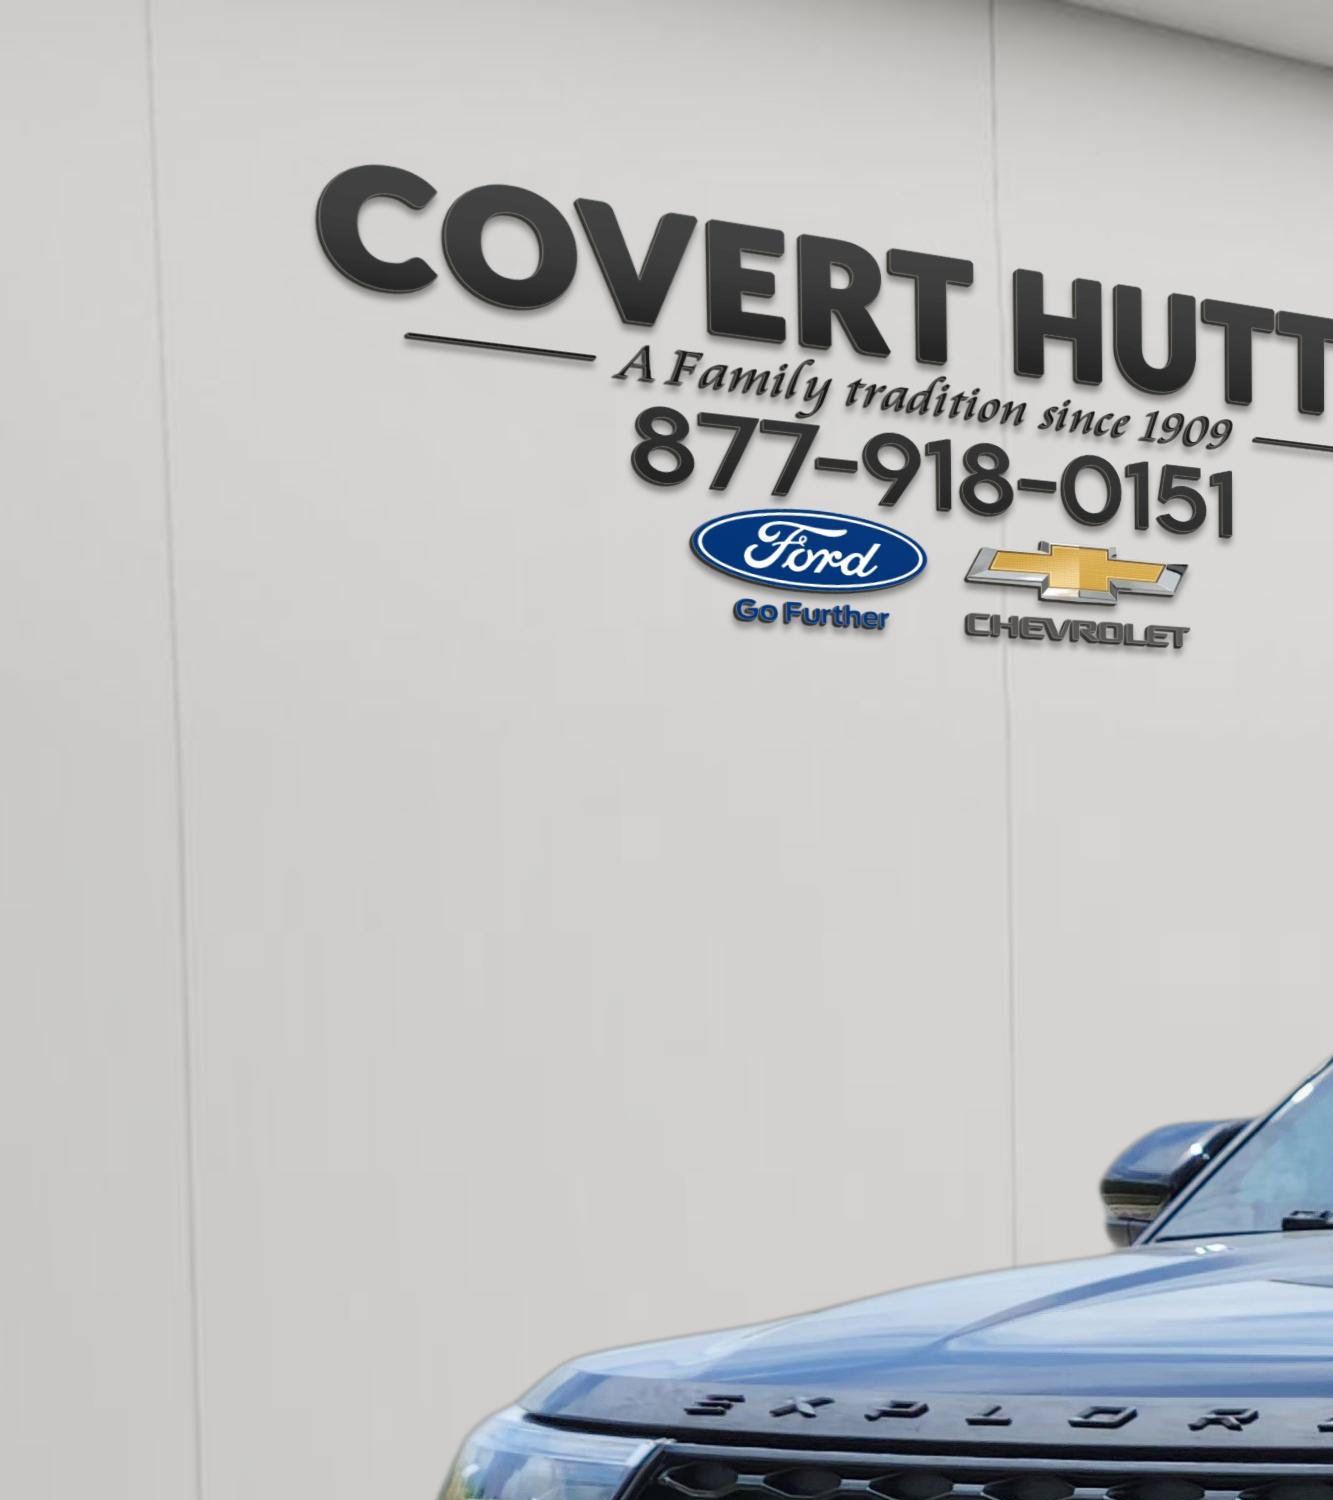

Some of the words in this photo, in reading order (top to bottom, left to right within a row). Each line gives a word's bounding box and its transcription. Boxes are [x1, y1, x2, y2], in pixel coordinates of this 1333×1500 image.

[315, 164, 974, 367] COVERT
[611, 345, 655, 385] A
[662, 349, 833, 420] Family
[845, 376, 1027, 427] tradition
[1036, 400, 1131, 440] since
[1138, 410, 1233, 450] 1909
[630, 406, 1233, 540] 877-918-0151
[743, 519, 882, 578] Ford
[733, 598, 779, 624] Go
[783, 601, 890, 631] Further
[964, 612, 1191, 650] CHEVROLET
